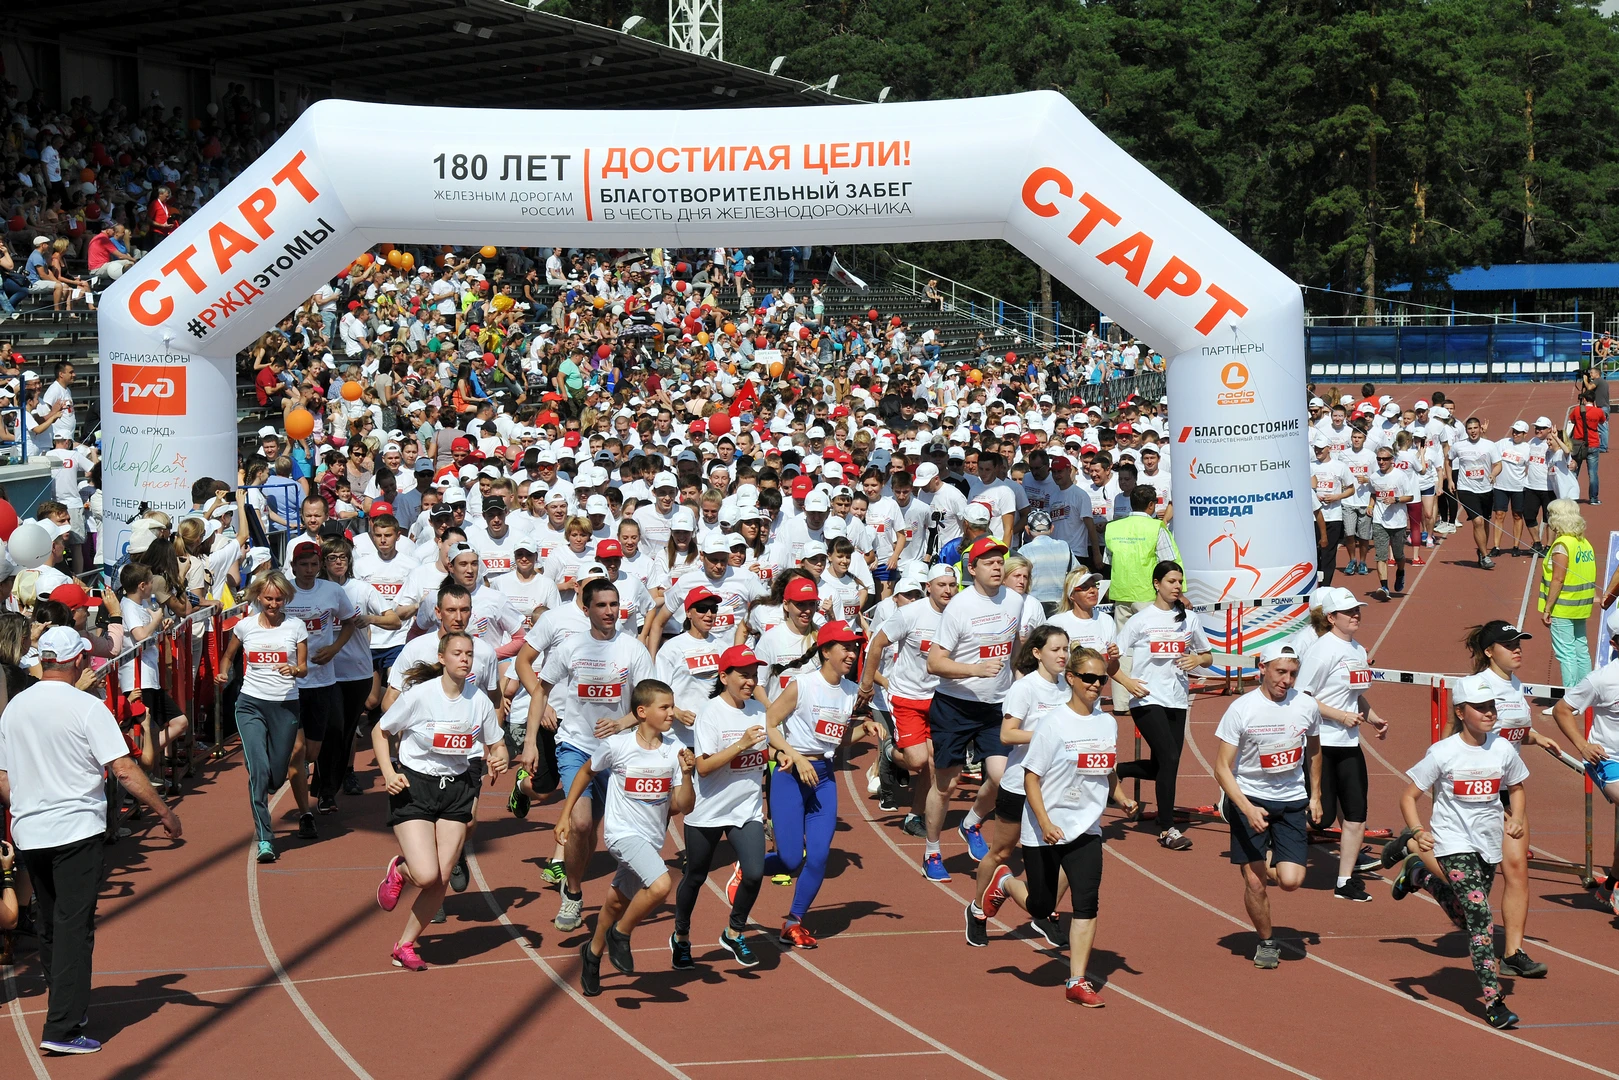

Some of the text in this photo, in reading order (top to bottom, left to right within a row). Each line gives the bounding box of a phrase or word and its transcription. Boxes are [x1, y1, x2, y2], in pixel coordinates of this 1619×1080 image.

[601, 140, 912, 179] ДОСТИГАЯ ЦЕЛИ!
[433, 153, 571, 182] 180 ЛЕТ
[433, 189, 573, 203] ЖЕЛЕЗНЫМ ДОРОГАМ
[600, 180, 913, 203] БЛАГОТВОРИТЕЛЬНЫЙ ЗАБЕГ
[521, 206, 575, 217] РОССИИ
[603, 202, 912, 222] В ЧЕСТЬ ДНЯ ЖЕЛЕЗНОДОРОЖНИКА
[128, 150, 320, 327] СТАРТ
[1021, 166, 1249, 337] СТАРТ
[187, 217, 336, 339] #РЖДэтоМЫ
[1201, 343, 1265, 356] ПАРТНЕРЫ
[109, 351, 191, 364] ОРГАНИЗАТОРЫ
[119, 425, 176, 436] ОАО «РЖД»
[1194, 418, 1299, 437] БЛАГОСОСТОЯНИЕ
[1196, 459, 1291, 475] Абсолют Банк
[1189, 489, 1294, 505] КОМСОМОЛЬСКАЯ
[1189, 505, 1254, 517] ПРАВДА
[487, 559, 505, 568] 303
[377, 585, 397, 594] 390
[843, 606, 856, 615] 98
[714, 615, 728, 626] 52
[987, 643, 1008, 657] 705
[1158, 642, 1179, 653] 216
[257, 652, 280, 663] 350
[694, 654, 716, 667] 741
[1355, 671, 1369, 682] 770
[587, 685, 614, 697] 675
[824, 722, 845, 738] 683
[1507, 729, 1525, 741] 189
[443, 735, 467, 748] 766
[740, 751, 764, 768] 226
[1086, 754, 1109, 768] 523
[1270, 750, 1296, 767] 387
[635, 778, 663, 792] 663
[1464, 780, 1493, 795] 788
